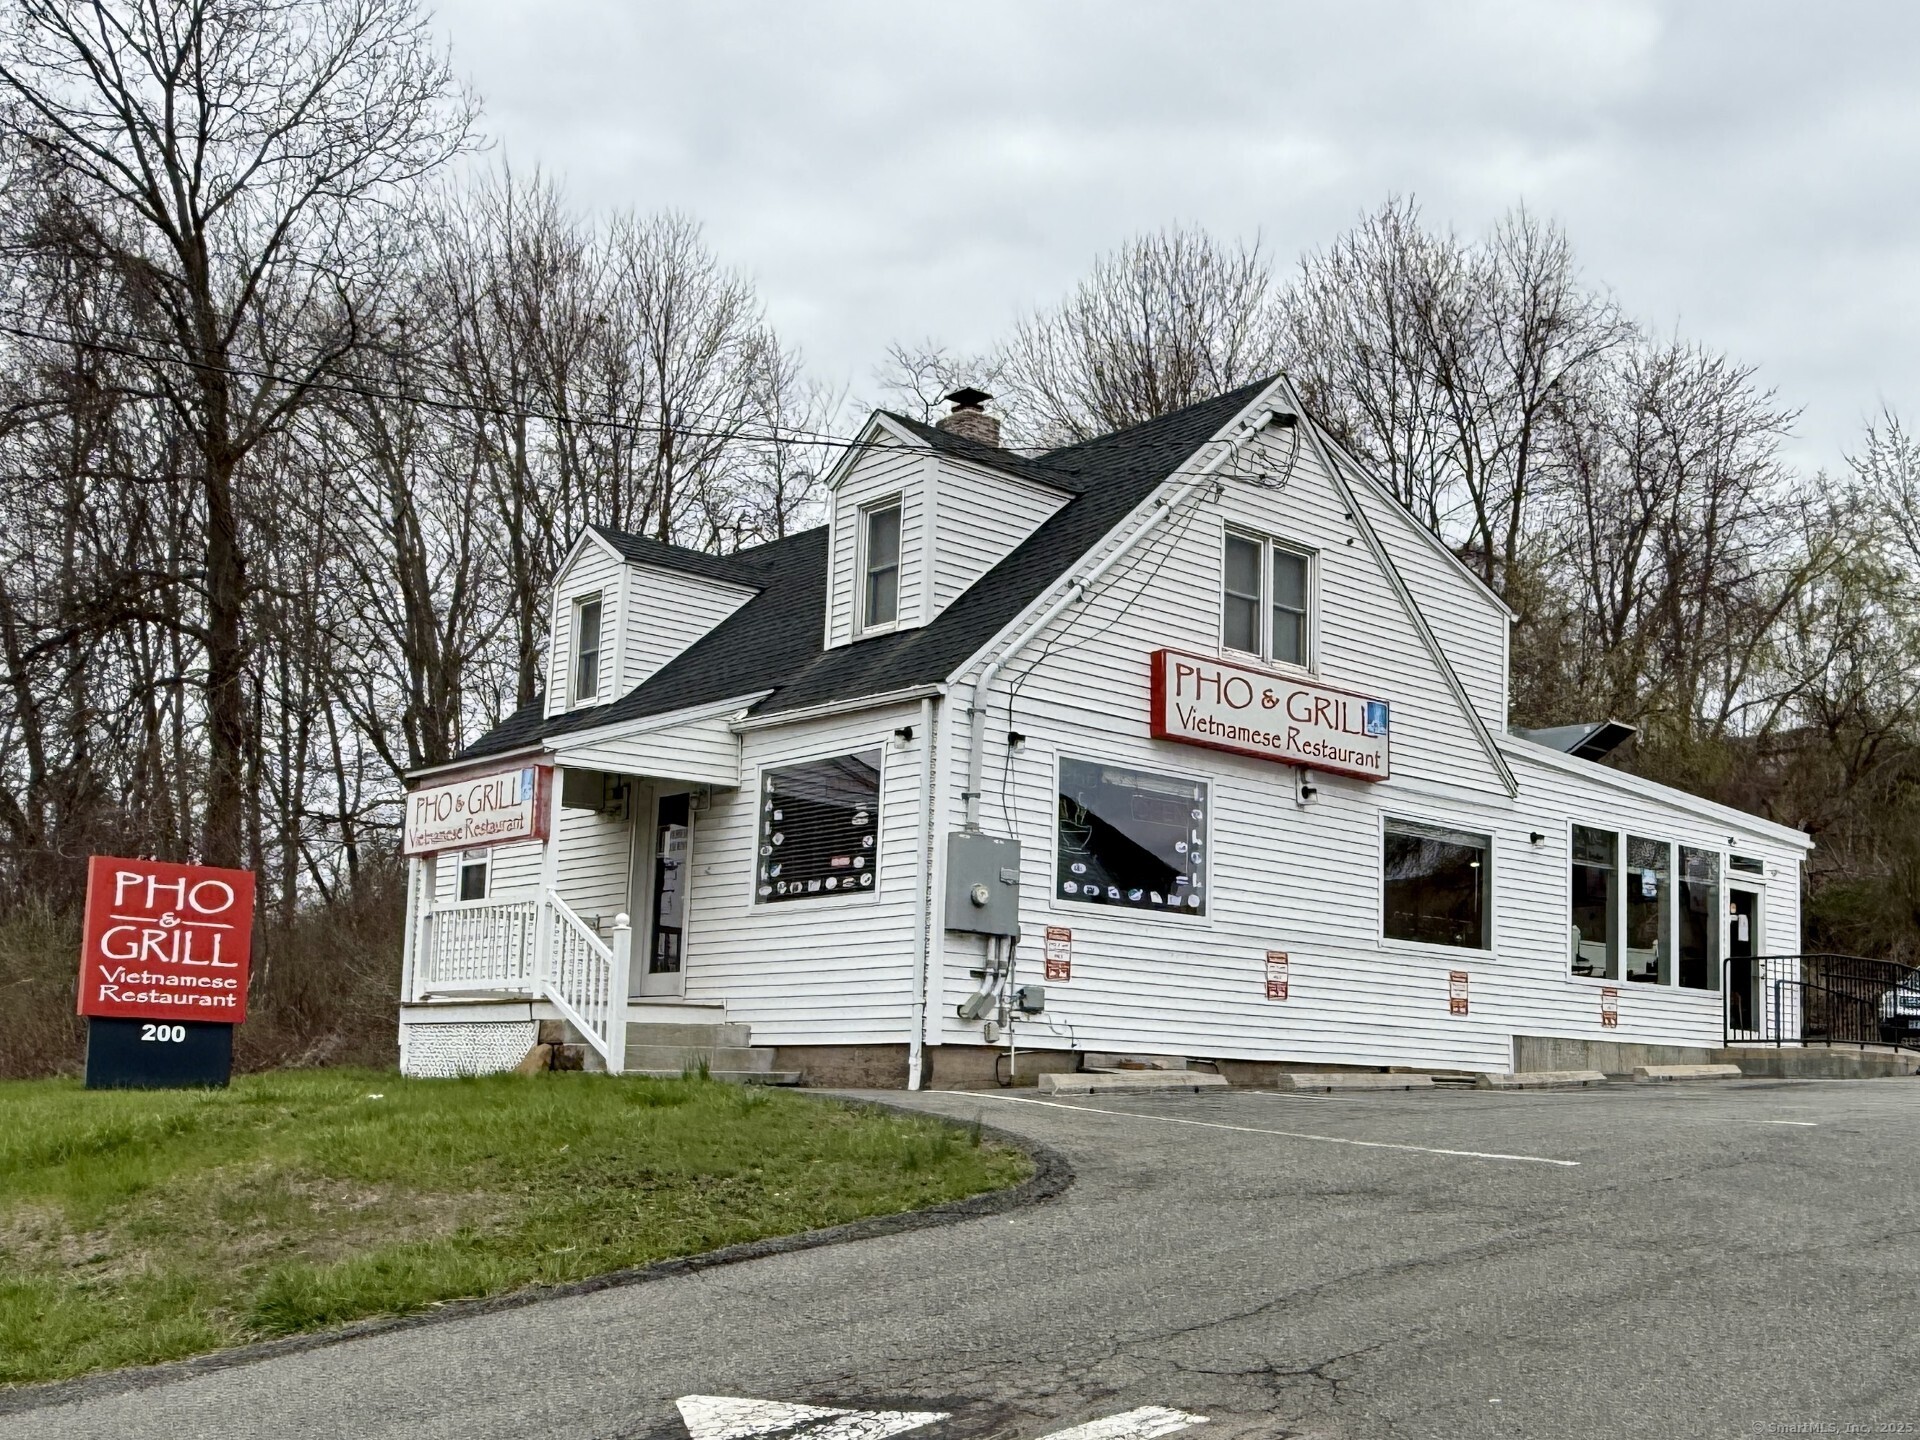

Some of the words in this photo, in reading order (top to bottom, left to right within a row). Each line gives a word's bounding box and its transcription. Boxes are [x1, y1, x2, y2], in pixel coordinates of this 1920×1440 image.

[1176, 662, 1253, 709] PHO
[1261, 688, 1280, 709] &
[1286, 691, 1378, 738] GRILL
[1176, 702, 1281, 748] Vietnamese
[1286, 725, 1381, 769] Restaurant
[416, 792, 452, 825] PHO
[468, 776, 522, 815] GRILL
[465, 812, 524, 840] Restaurant
[114, 871, 235, 914] PHO
[158, 911, 181, 928] &
[100, 925, 239, 967] GRILL
[98, 964, 238, 989] Vietnamese
[98, 984, 237, 1007] Restaurant
[140, 1023, 186, 1043] 200
